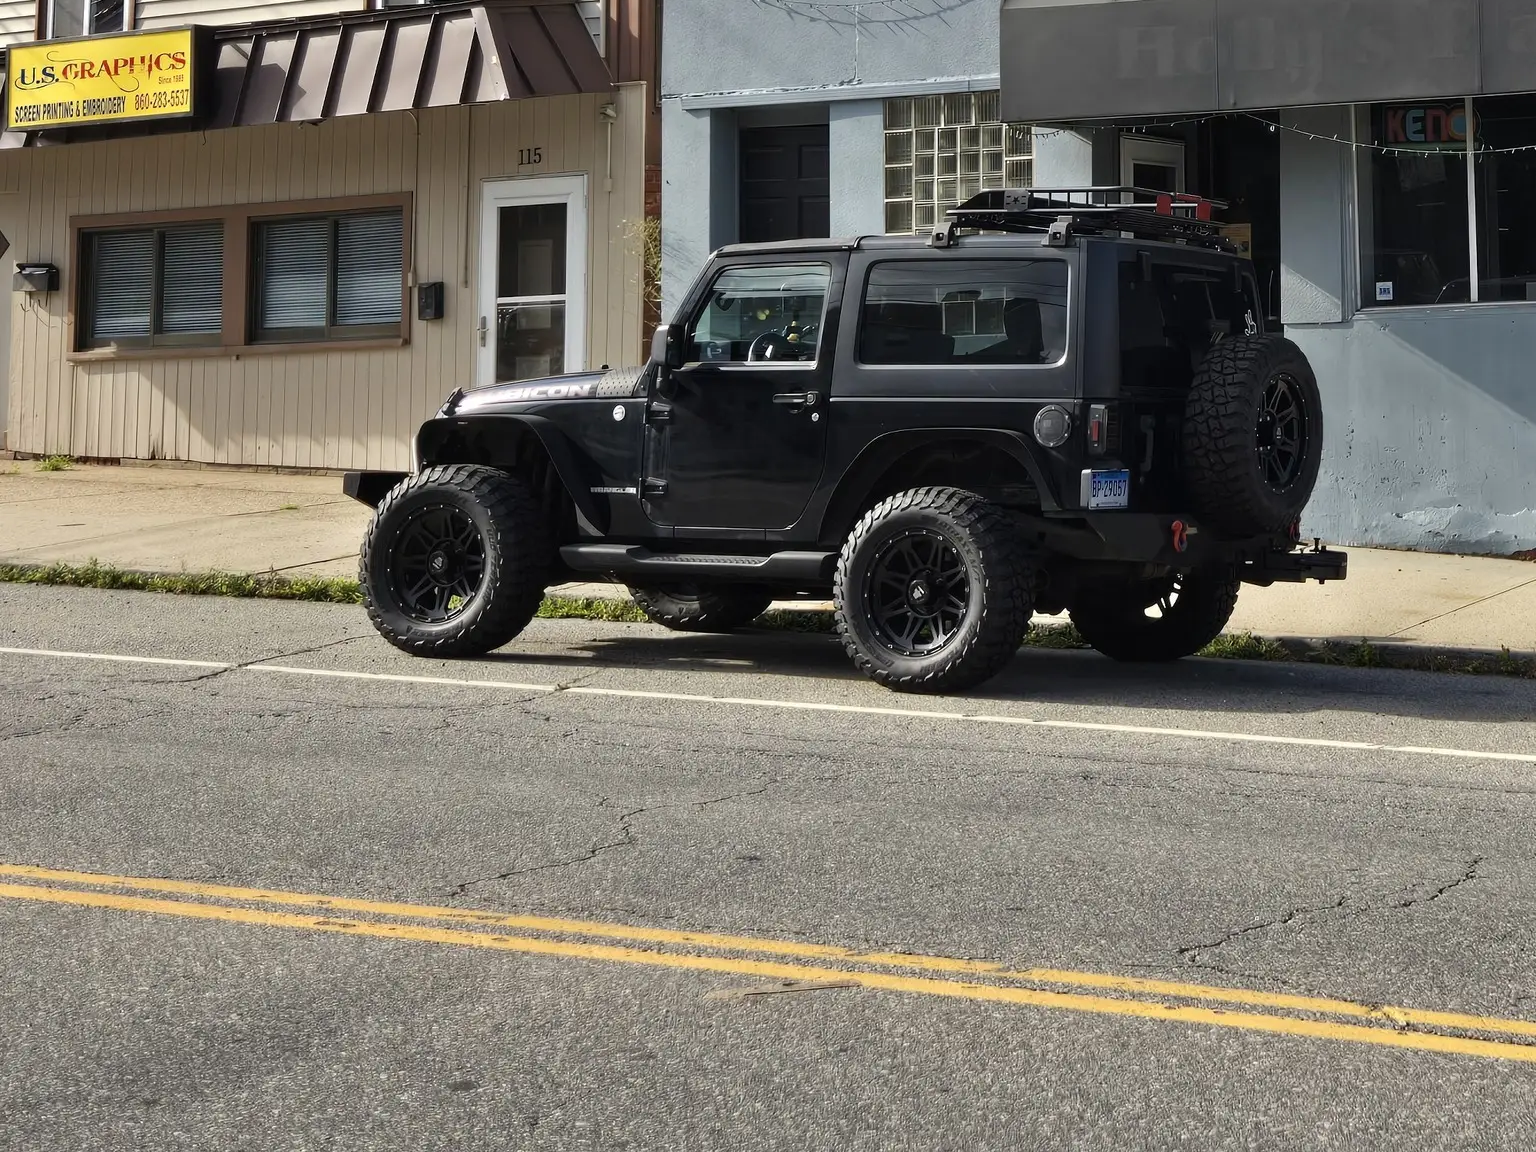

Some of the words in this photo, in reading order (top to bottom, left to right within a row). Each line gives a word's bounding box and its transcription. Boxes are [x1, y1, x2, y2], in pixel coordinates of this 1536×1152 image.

[20, 67, 59, 86] U.S.
[62, 52, 186, 79] GRAPHICS
[14, 104, 41, 123] SCREEN
[42, 100, 74, 120] PRINTING
[75, 100, 81, 118] &
[82, 95, 127, 117] EMBROIDERY
[134, 88, 190, 111] 860-283-5537
[1387, 107, 1476, 142] KENO
[518, 147, 542, 166] 115
